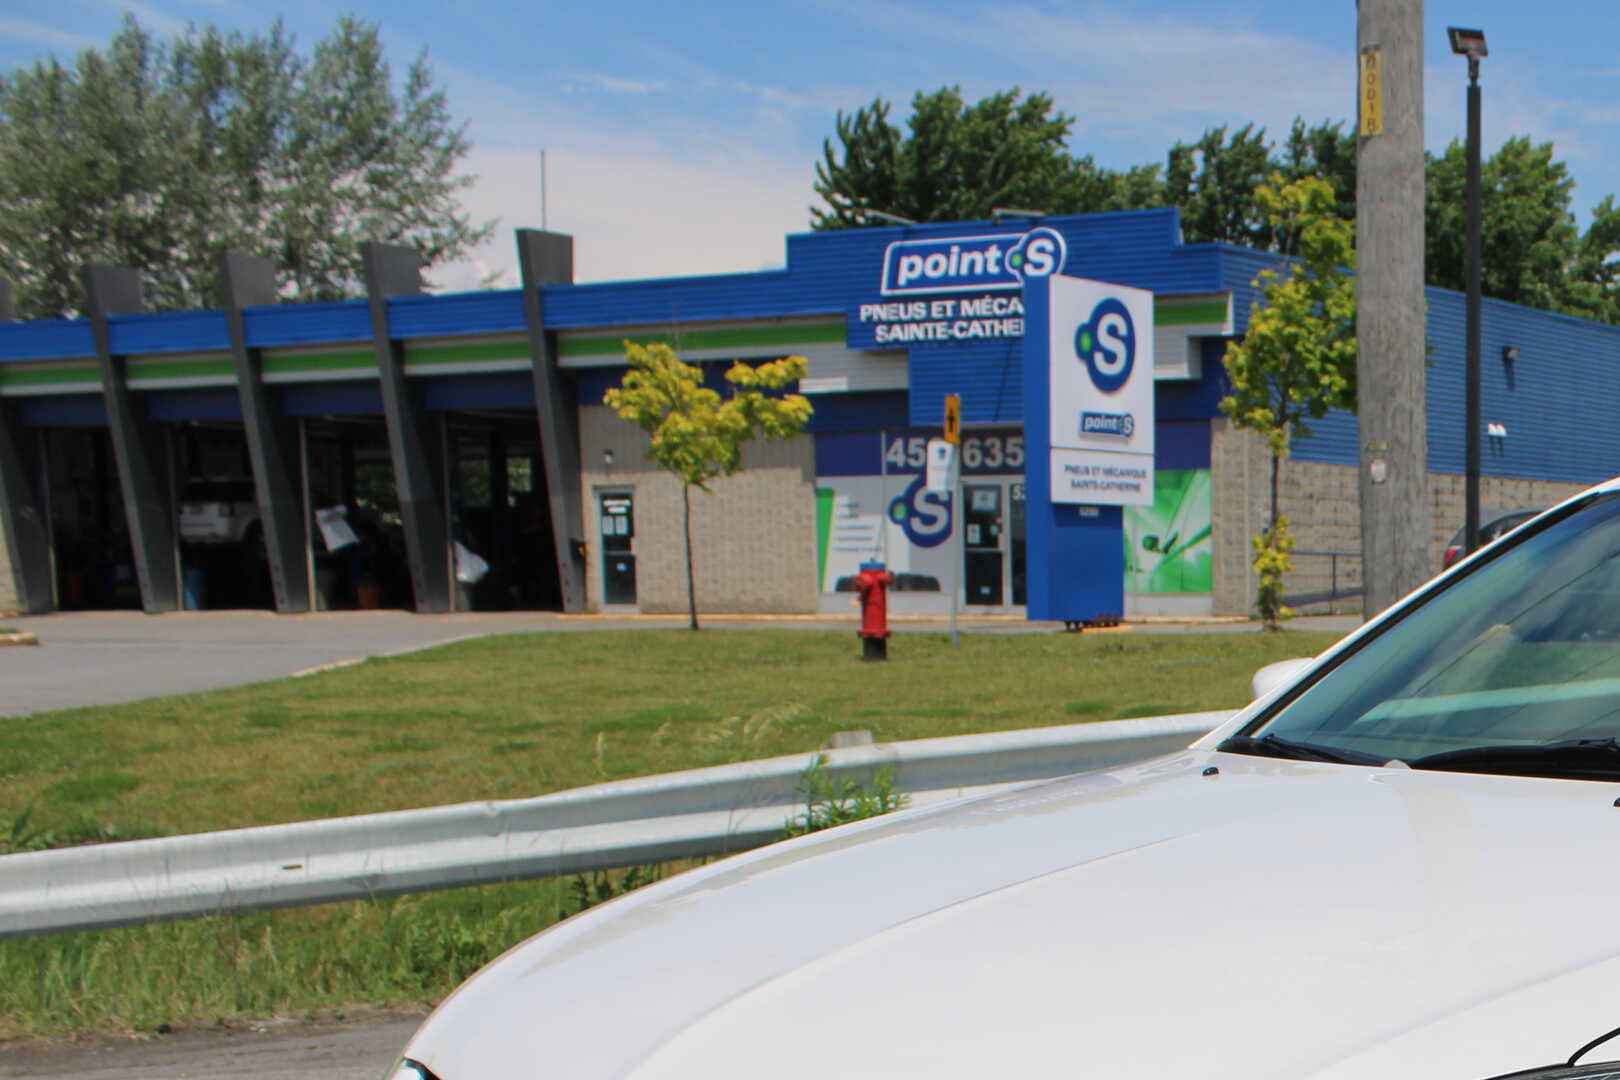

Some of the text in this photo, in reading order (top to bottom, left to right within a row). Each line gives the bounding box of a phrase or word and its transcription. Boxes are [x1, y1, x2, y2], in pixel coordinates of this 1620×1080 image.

[897, 238, 1055, 286] point S
[860, 302, 926, 322] PNEUS
[931, 300, 955, 318] ET
[875, 318, 1025, 342] SAINTE-CATHE
[1093, 312, 1128, 376] S
[1084, 415, 1118, 432] point
[963, 436, 1025, 468] 635
[909, 484, 949, 536] S
